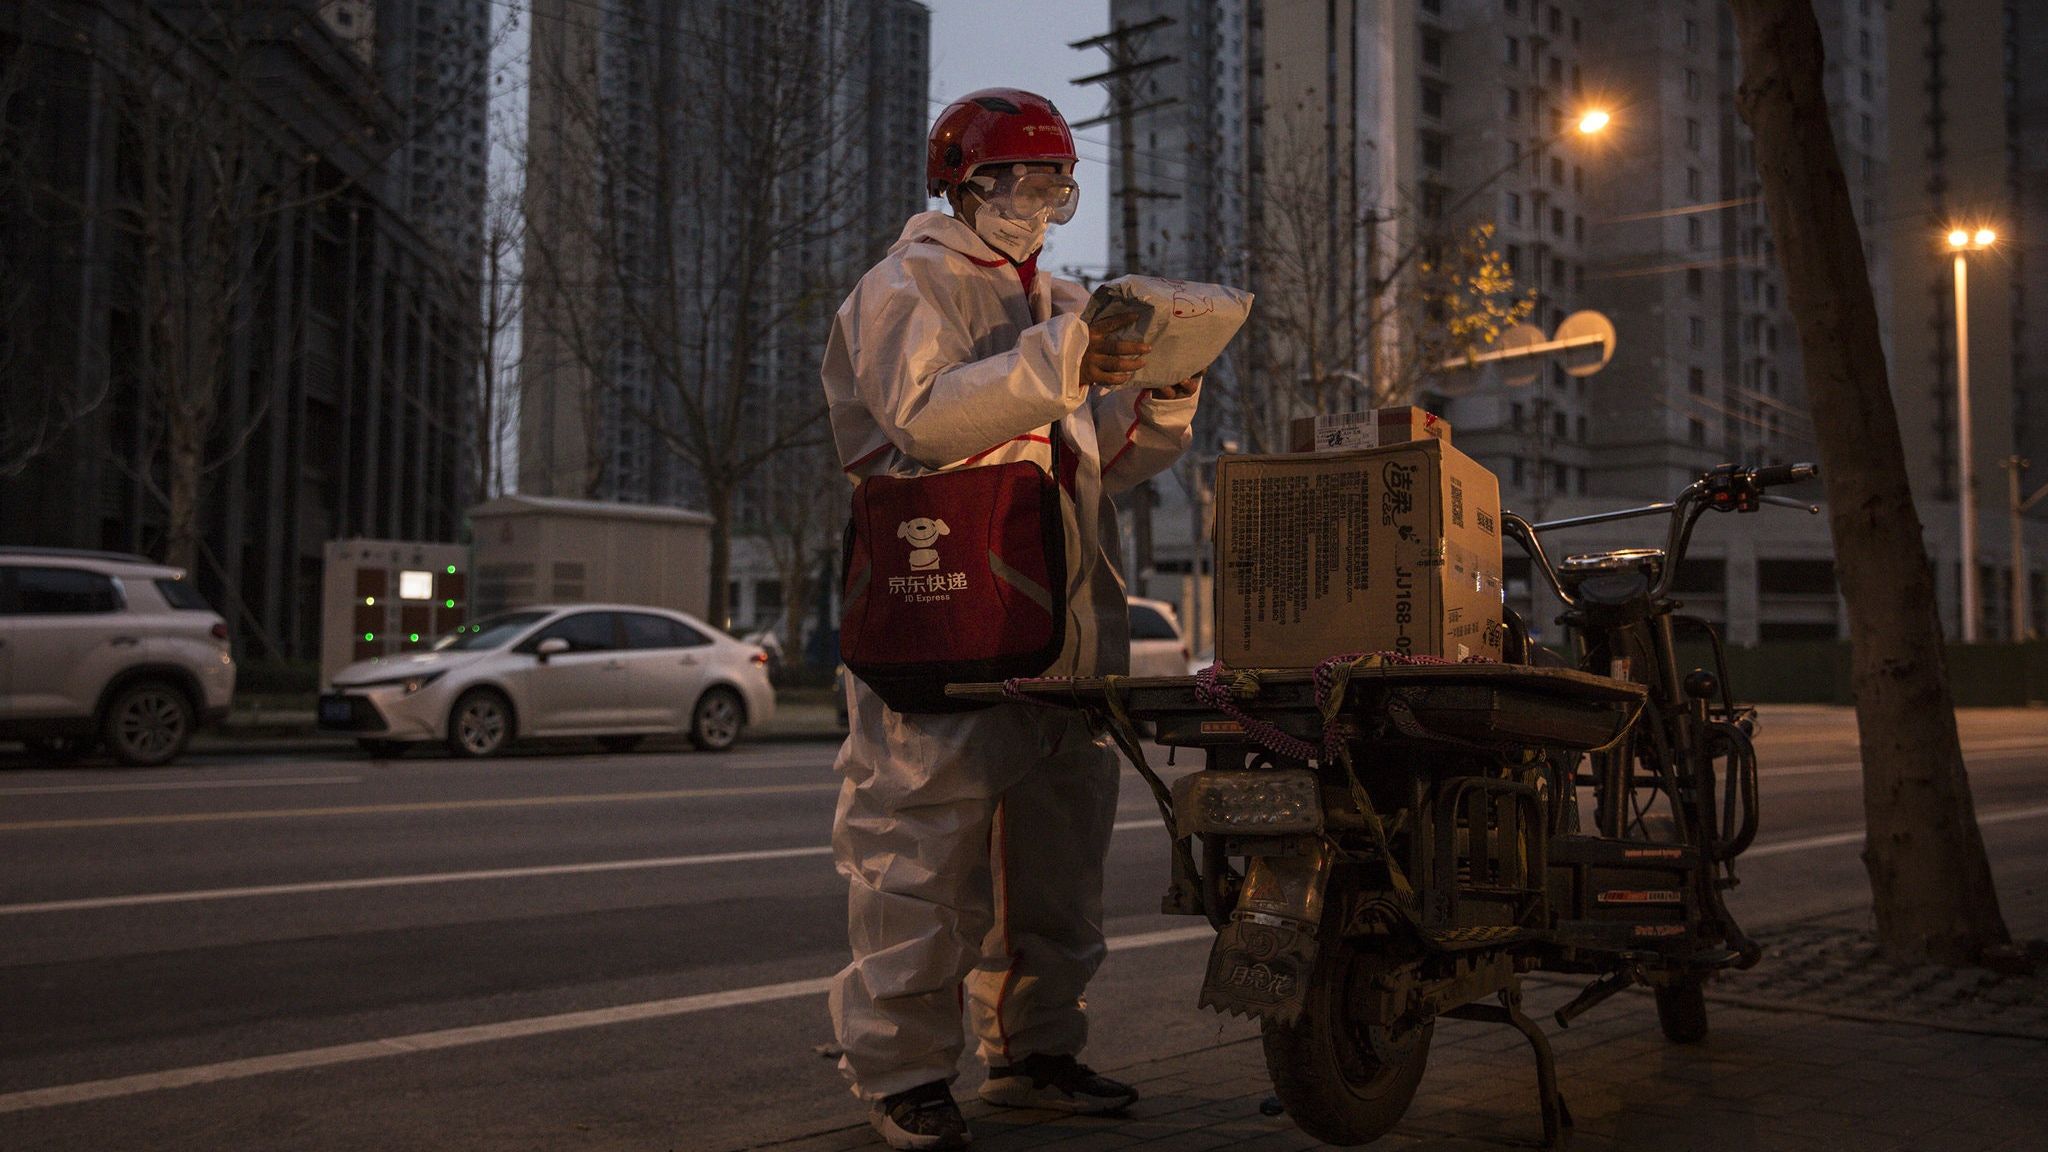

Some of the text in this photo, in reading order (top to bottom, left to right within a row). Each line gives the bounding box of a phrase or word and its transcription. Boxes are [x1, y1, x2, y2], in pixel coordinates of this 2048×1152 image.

[888, 572, 968, 594] 京东快递
[916, 594, 951, 603] Express
